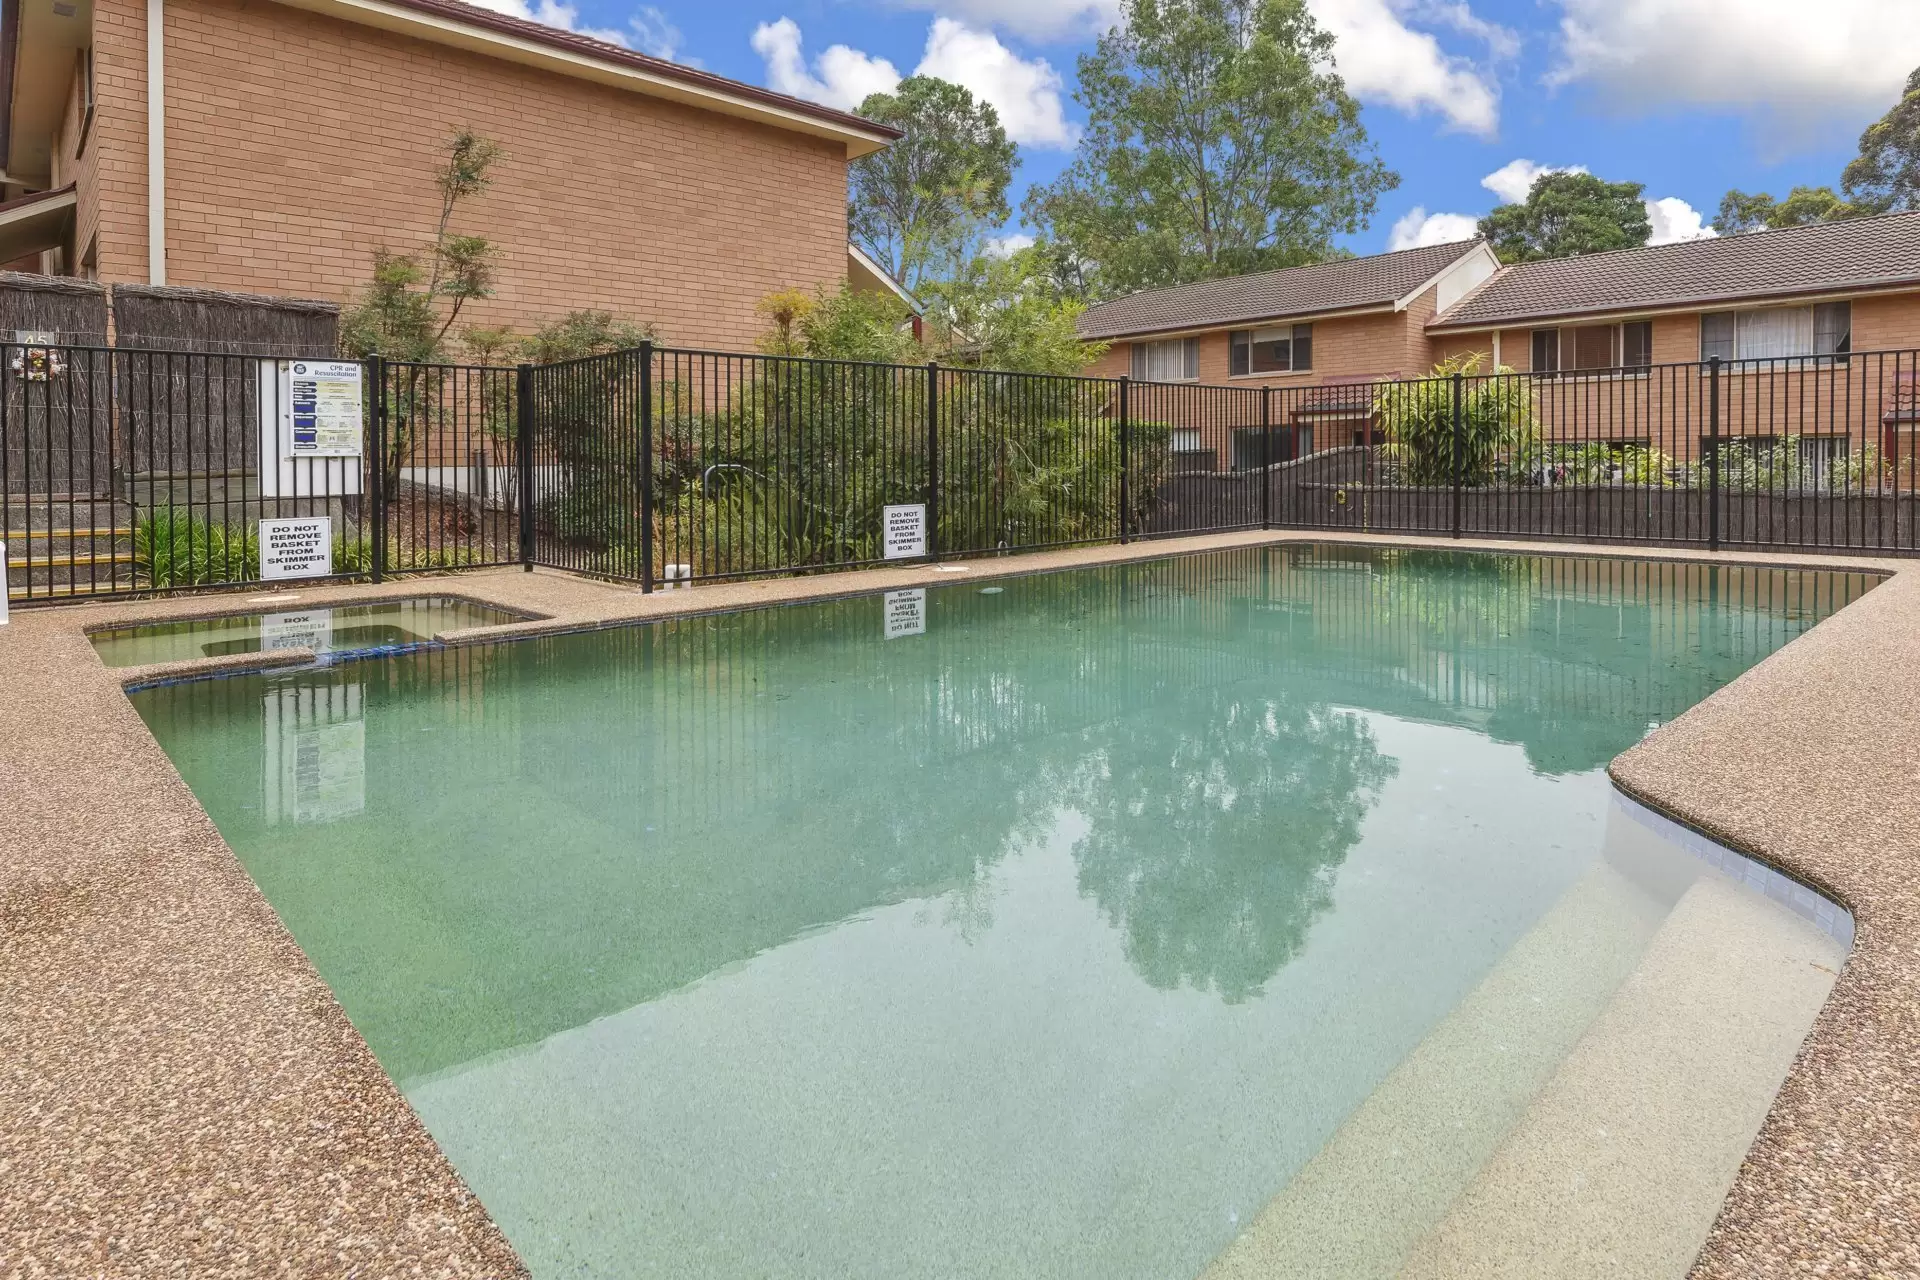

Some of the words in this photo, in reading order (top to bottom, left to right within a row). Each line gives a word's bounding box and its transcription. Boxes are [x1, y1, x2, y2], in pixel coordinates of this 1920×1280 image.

[314, 369, 357, 377] Resuscitation
[270, 532, 322, 541] REMOVE
[271, 540, 320, 548] BASKET
[888, 537, 922, 545] SKIMMER
[279, 548, 314, 556] FROM
[267, 555, 325, 564] SKIMMER
